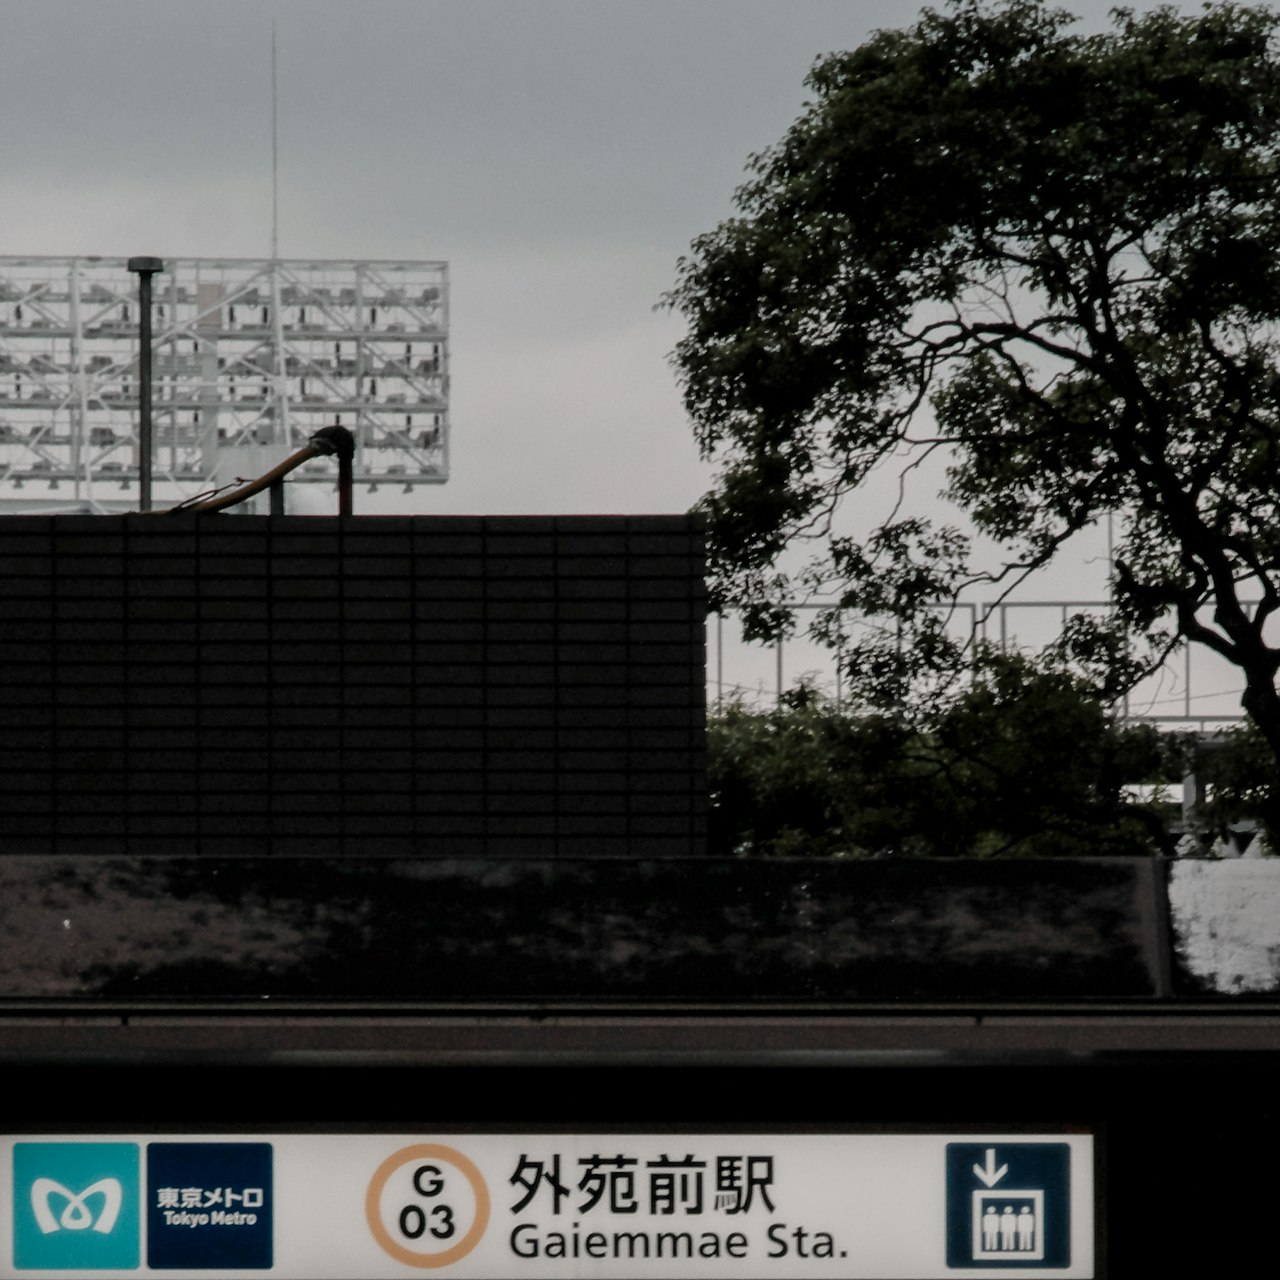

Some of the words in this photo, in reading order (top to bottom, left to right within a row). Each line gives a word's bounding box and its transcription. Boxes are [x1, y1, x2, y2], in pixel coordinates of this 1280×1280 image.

[157, 1187, 263, 1208] 東京メトロ
[413, 1165, 444, 1197] G
[509, 1153, 776, 1216] 外苑前駅
[163, 1211, 208, 1228] Tokyo
[210, 1211, 257, 1226] Metro
[399, 1205, 455, 1239] 03
[509, 1222, 749, 1259] Gaiemmae
[767, 1223, 847, 1259] Sta.
